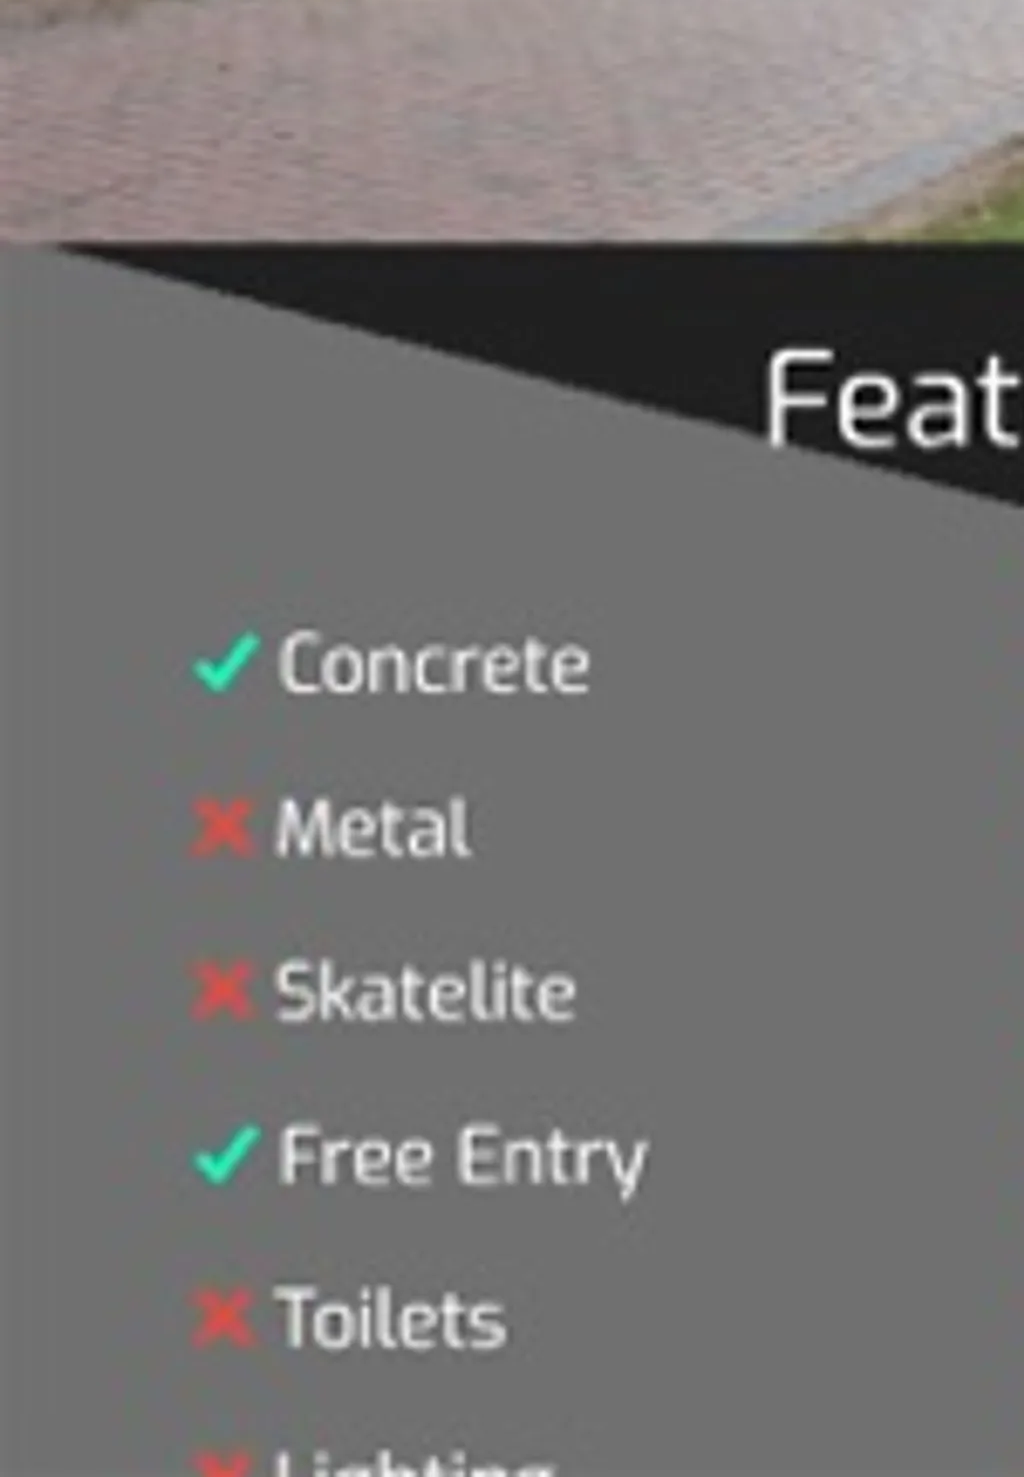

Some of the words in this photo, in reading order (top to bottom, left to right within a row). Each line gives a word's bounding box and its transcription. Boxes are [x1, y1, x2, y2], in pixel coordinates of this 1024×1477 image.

[281, 630, 589, 694] Concrete
[277, 799, 470, 857] Metal
[277, 959, 576, 1021] Skatelite
[282, 1125, 433, 1184] Free
[459, 1125, 648, 1200] Entry
[276, 1286, 506, 1349] Toilets
